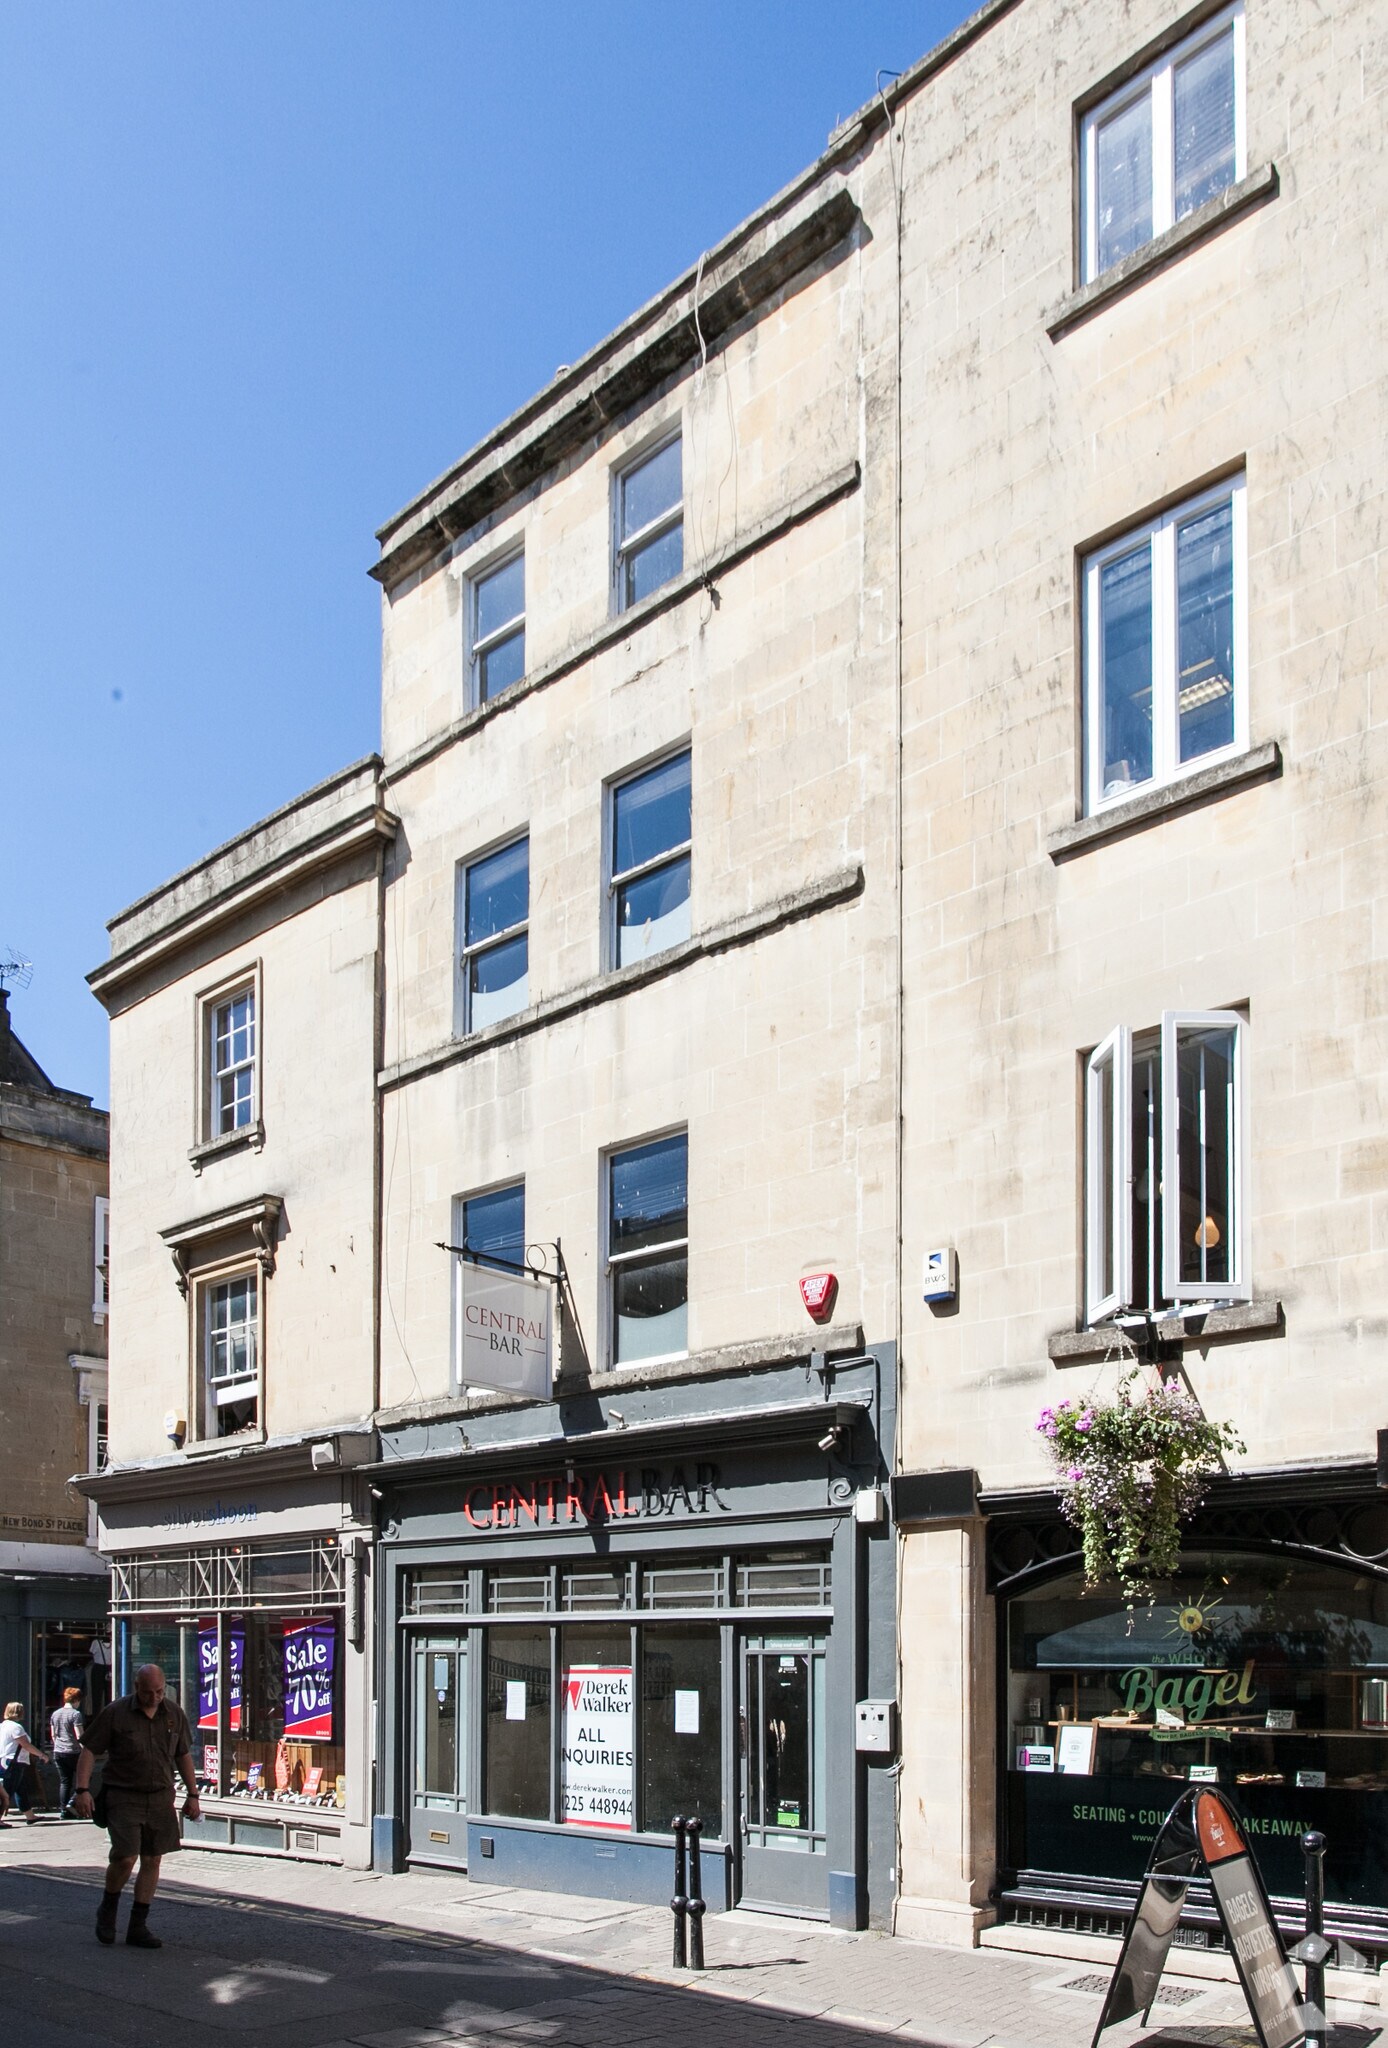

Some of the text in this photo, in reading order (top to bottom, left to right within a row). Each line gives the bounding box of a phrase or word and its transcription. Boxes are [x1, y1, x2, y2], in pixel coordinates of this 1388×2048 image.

[925, 1273, 946, 1285] BWS
[465, 1304, 546, 1340] CENTRAL
[489, 1332, 523, 1357] BAR
[463, 1463, 732, 1529] CENTRAL BAR
[163, 1500, 258, 1531] silvershoon
[201, 1641, 238, 1668] Sae
[286, 1638, 327, 1673] Sale
[1152, 1654, 1165, 1664] the
[318, 1692, 331, 1707] off
[586, 1678, 628, 1695] Derek
[1119, 1659, 1257, 1723] Bagel
[582, 1696, 631, 1713] Walker
[577, 1727, 606, 1743] ALL
[562, 1747, 632, 1766] NQUIRIES
[1073, 1804, 1126, 1823] SEATING
[1139, 1810, 1166, 1826] COU
[1225, 1890, 1258, 1924] BAGELS
[1233, 1923, 1276, 1963] BAGUETTES
[1250, 1961, 1282, 1998] WRAPS
